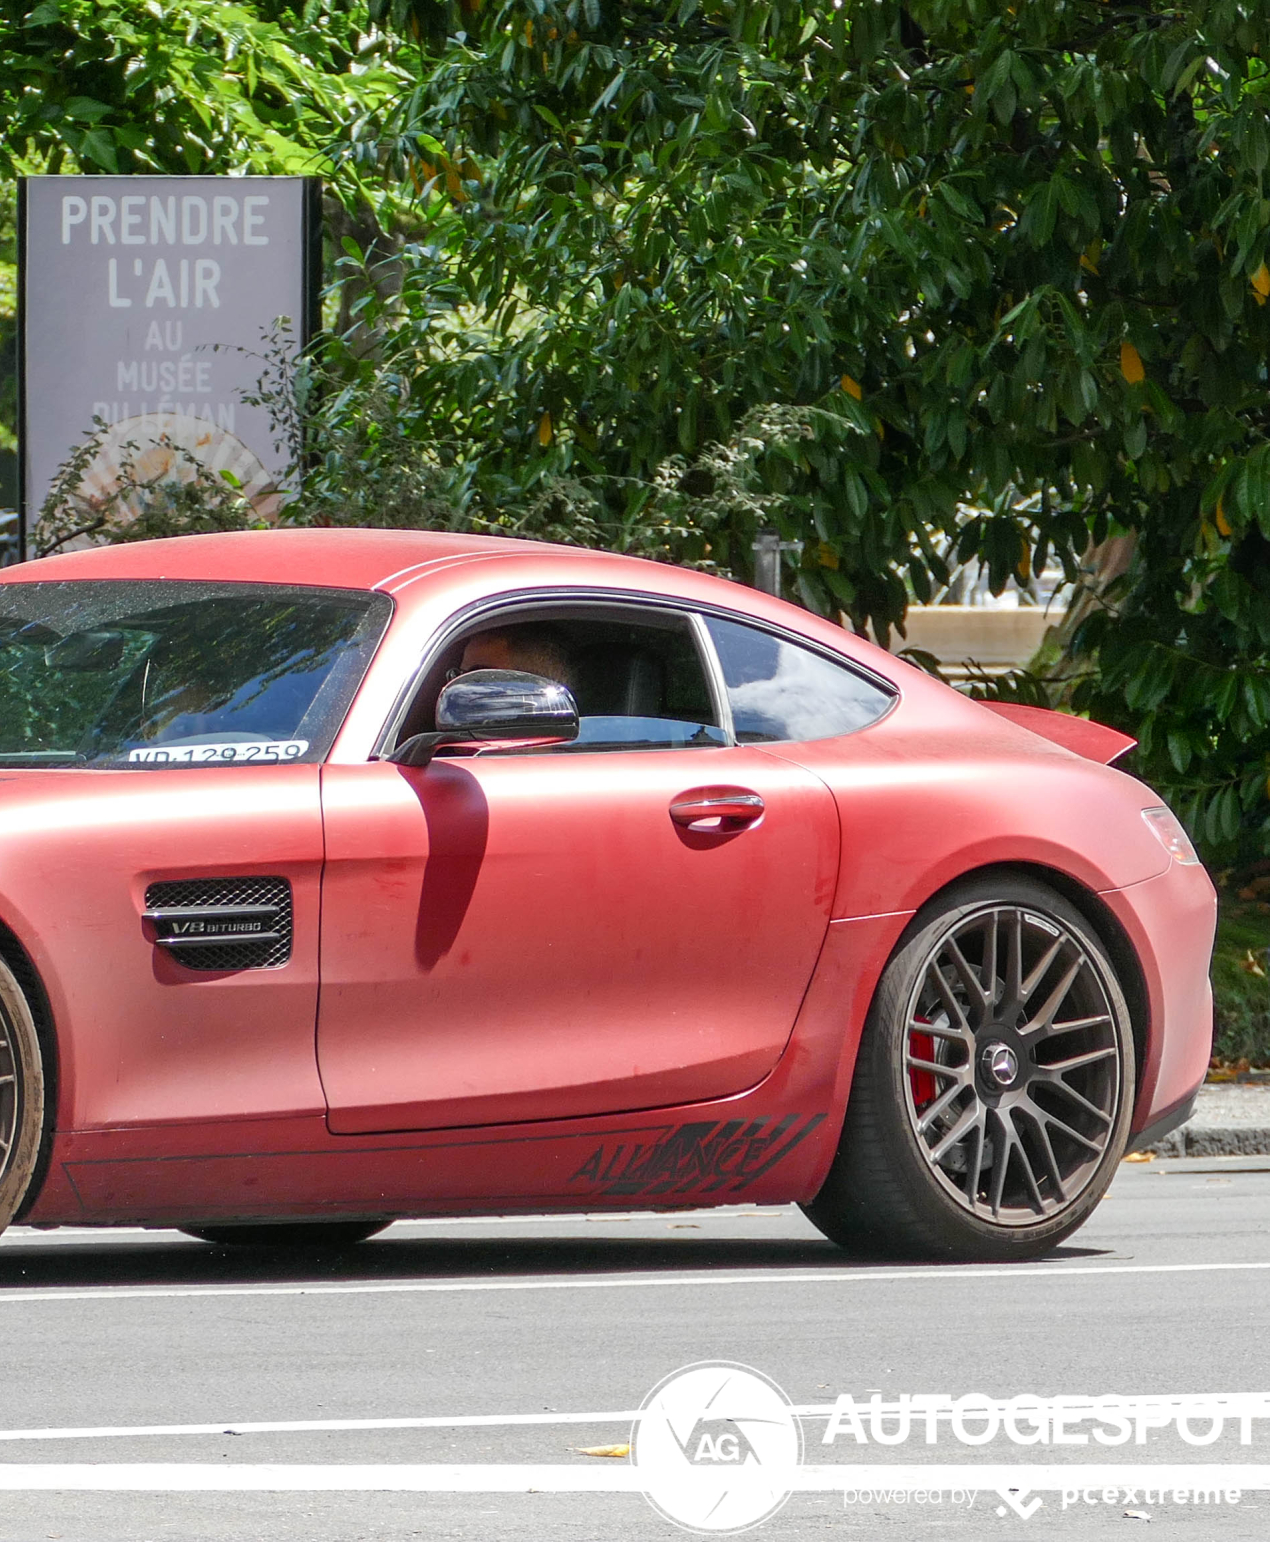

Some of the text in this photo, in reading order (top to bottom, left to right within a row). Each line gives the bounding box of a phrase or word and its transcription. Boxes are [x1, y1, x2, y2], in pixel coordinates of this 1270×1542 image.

[61, 195, 270, 246] PRENDRE
[108, 258, 221, 308] L'AIR
[144, 320, 182, 351] AU
[117, 353, 212, 393] MUSÉE
[172, 922, 262, 934] V8 BITURBO
